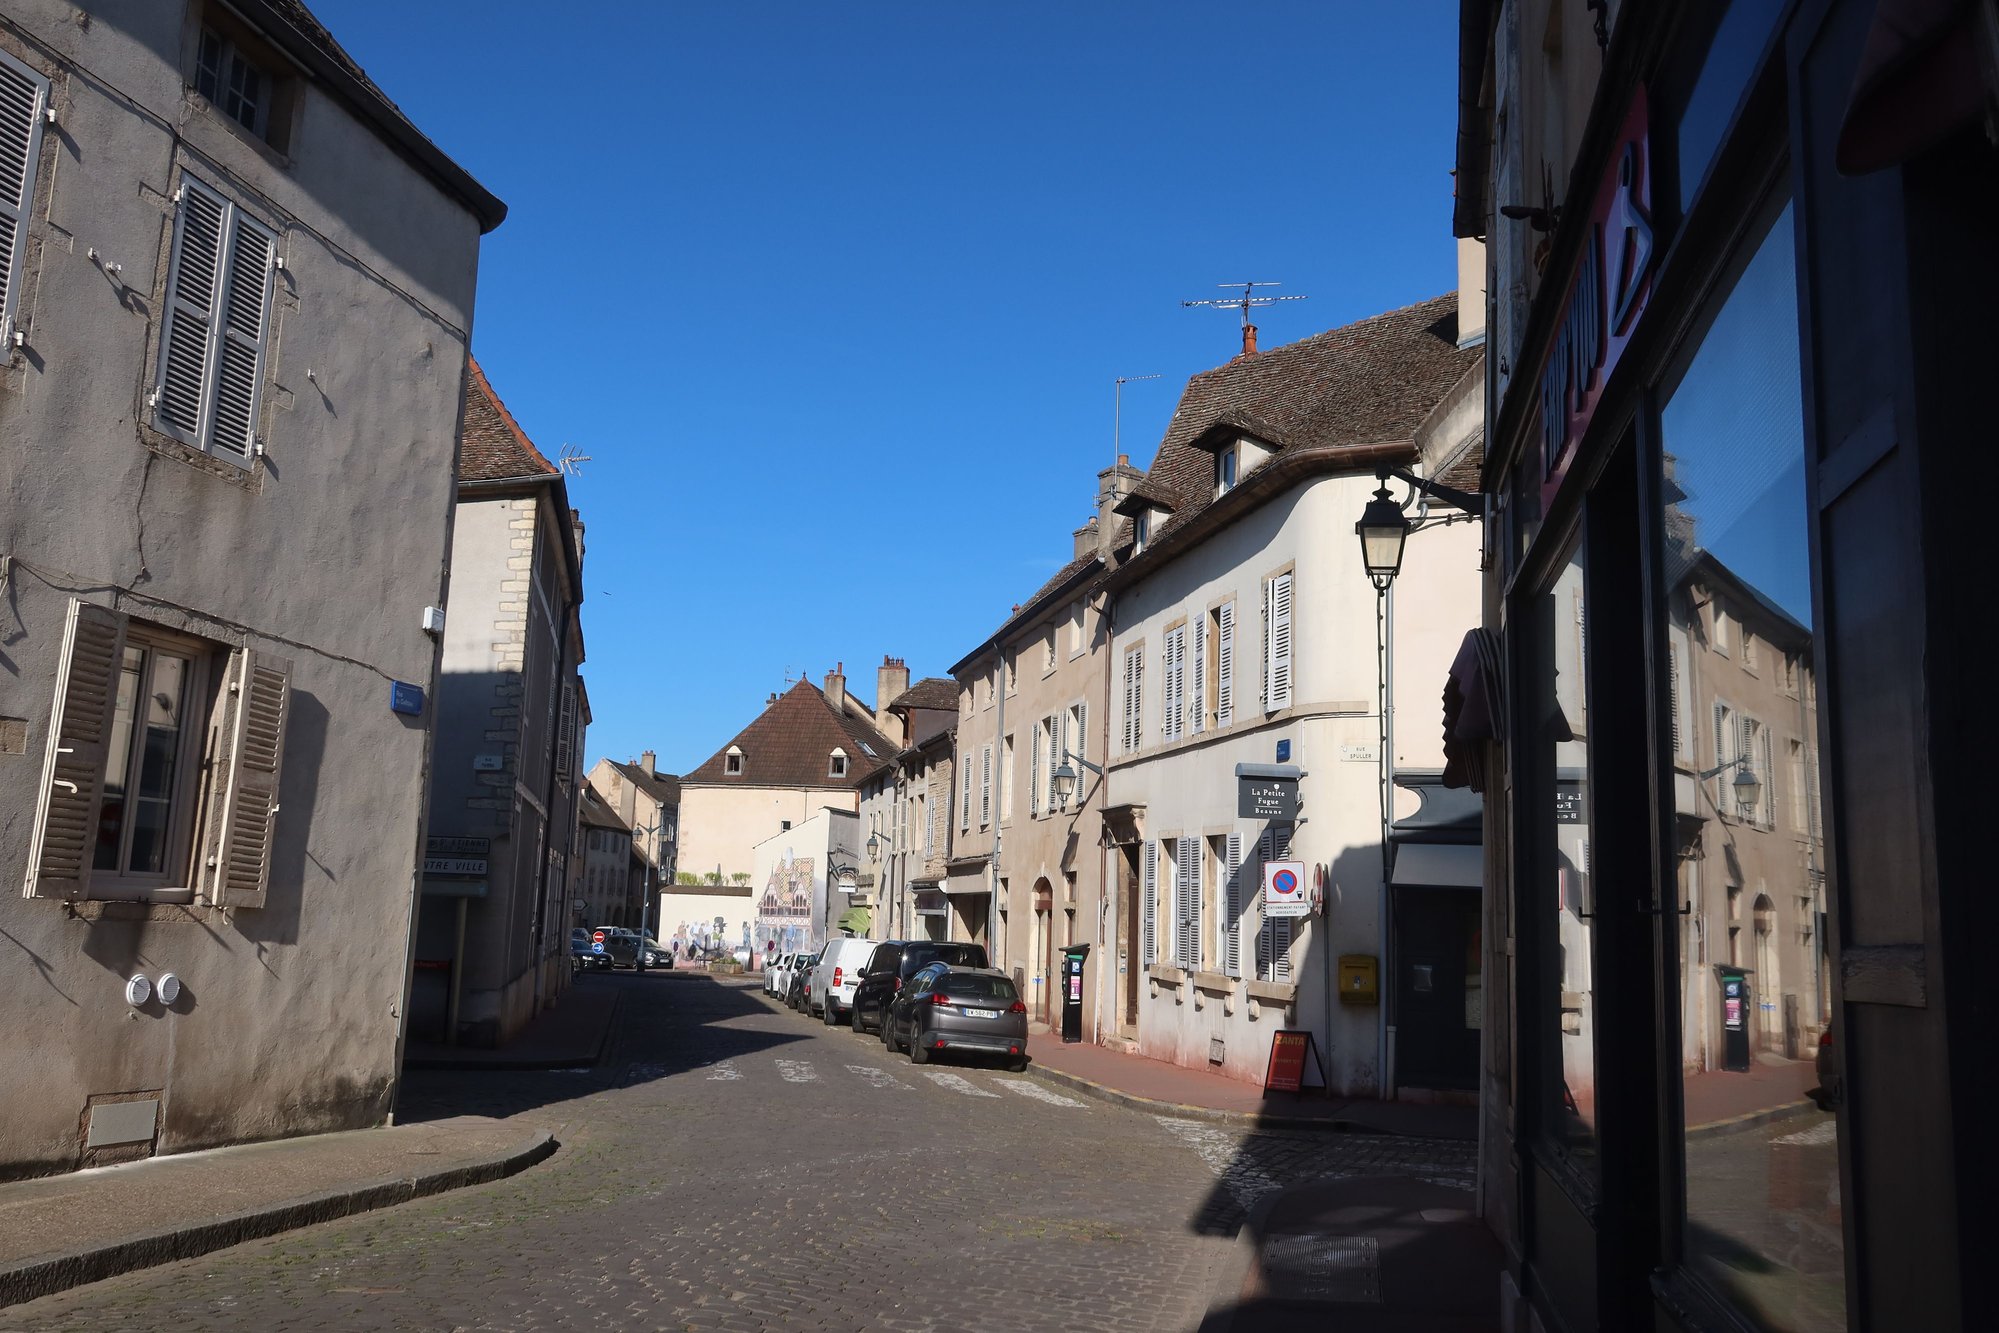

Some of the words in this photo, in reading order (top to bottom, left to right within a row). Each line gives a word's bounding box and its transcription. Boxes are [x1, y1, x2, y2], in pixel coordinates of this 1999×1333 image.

[1251, 788, 1261, 796] La
[1263, 788, 1285, 797] Petite
[1258, 797, 1279, 806] Fugue
[1255, 807, 1282, 815] Beaune
[456, 861, 484, 871] VILLE
[1276, 1036, 1305, 1046] ZANTA
